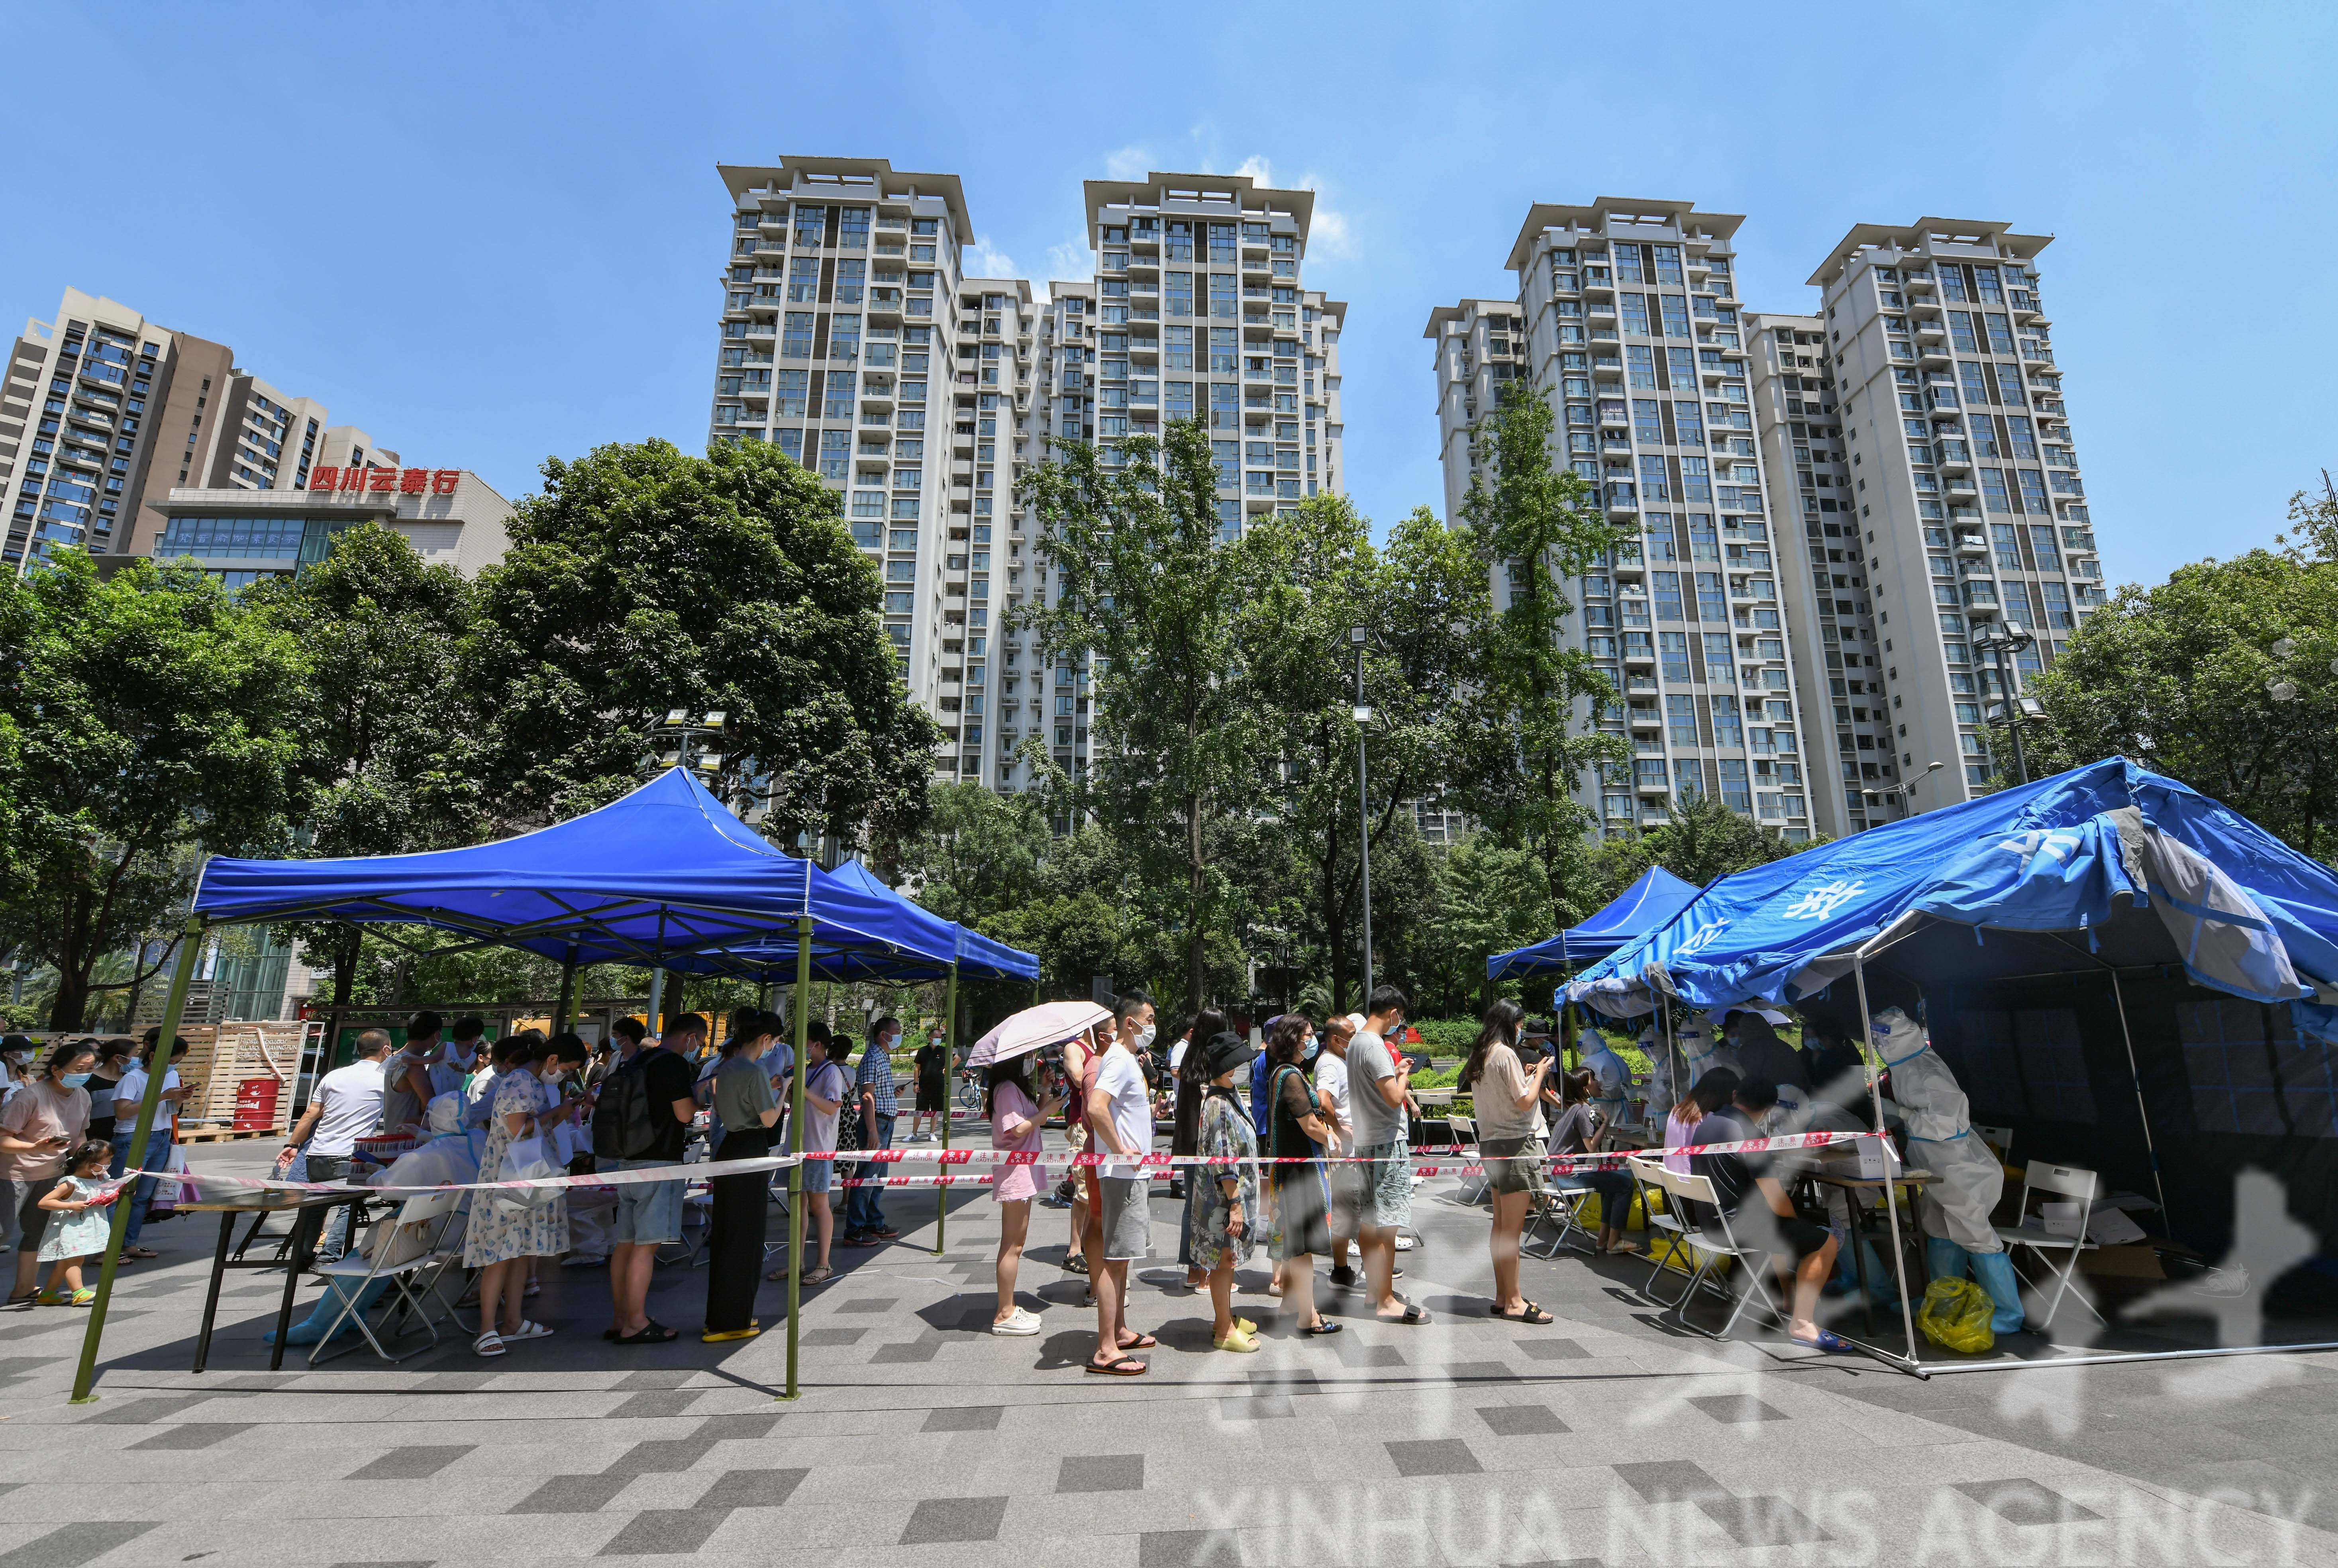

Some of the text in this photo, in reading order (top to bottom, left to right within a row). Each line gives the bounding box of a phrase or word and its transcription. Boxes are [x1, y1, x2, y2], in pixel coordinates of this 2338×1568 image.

[309, 466, 459, 493] 四川云泰行
